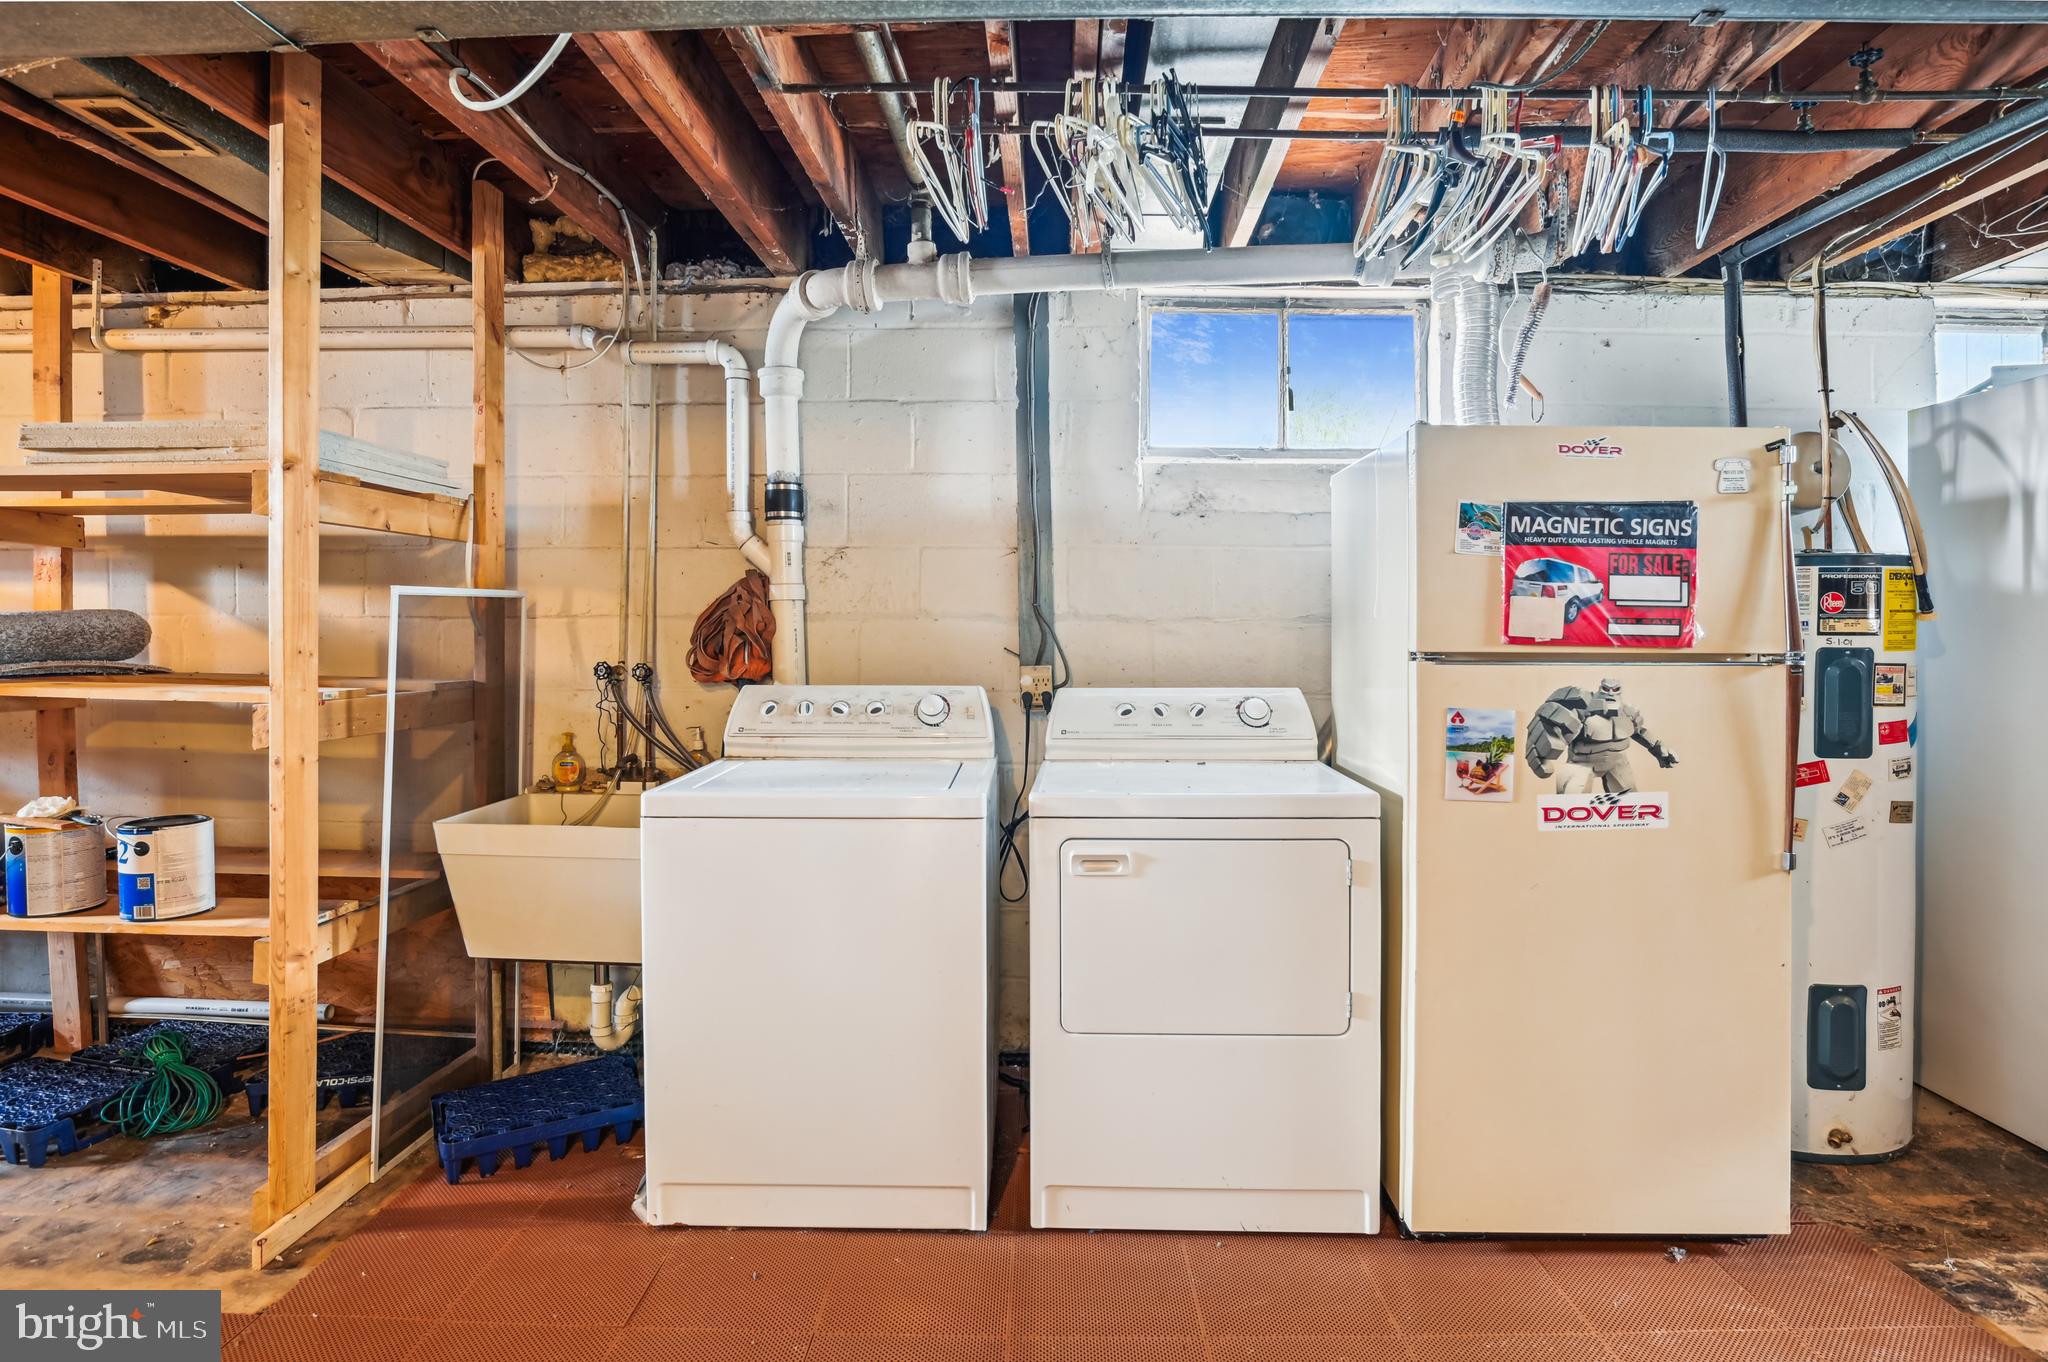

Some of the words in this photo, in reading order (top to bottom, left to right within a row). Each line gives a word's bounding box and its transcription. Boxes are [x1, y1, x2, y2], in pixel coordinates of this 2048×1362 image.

[1558, 444, 1622, 455] DOVER
[1511, 516, 1624, 536] MAGNETIC
[1630, 518, 1692, 537] SIGNS
[1610, 556, 1639, 574] FOR
[1643, 556, 1682, 574] SALE
[1850, 580, 1879, 595] 50
[1541, 804, 1664, 822] DOVER
[118, 841, 129, 864] 2
[316, 1075, 374, 1087] EPSI-COLA
